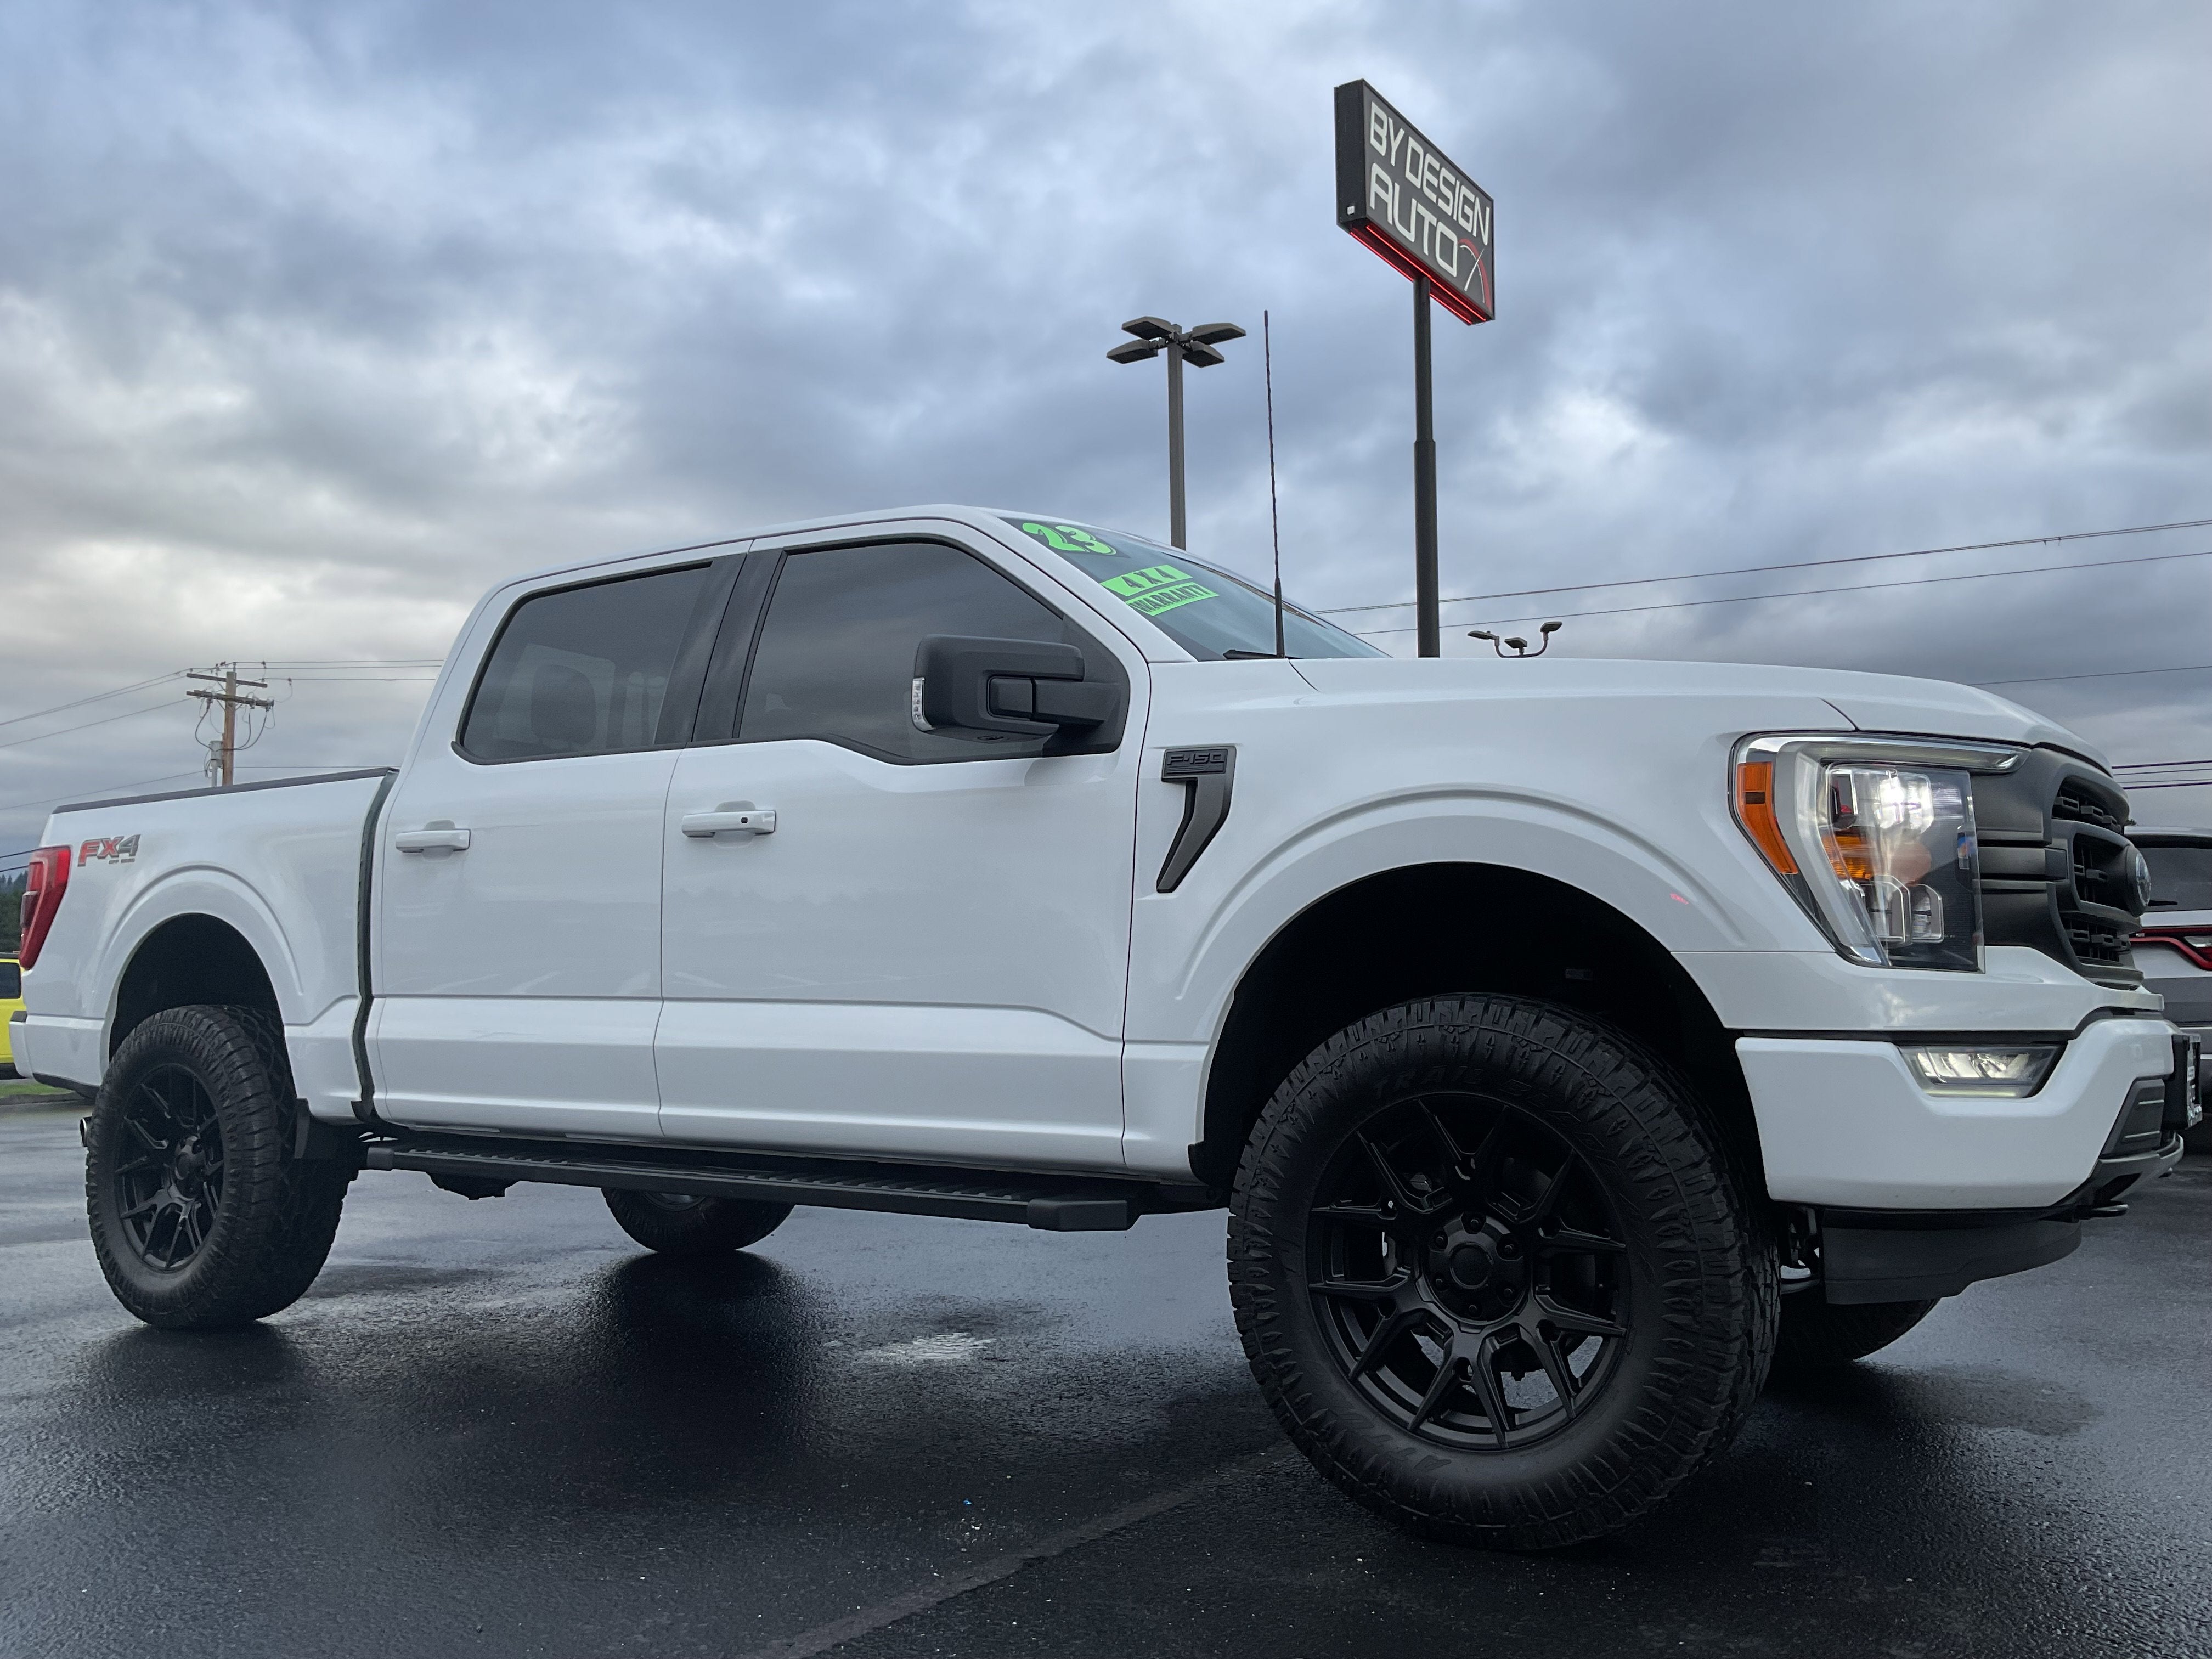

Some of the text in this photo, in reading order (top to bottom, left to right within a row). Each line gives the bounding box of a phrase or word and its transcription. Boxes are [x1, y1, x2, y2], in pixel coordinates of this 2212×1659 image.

[1370, 101, 1490, 246] BY DESIGN
[1370, 163, 1458, 277] AUTO
[1022, 522, 1116, 555] 23
[1127, 584, 1211, 613] WARRANTY
[1166, 752, 1226, 765] F-150
[77, 834, 141, 867] FX4
[1372, 1064, 1485, 1100] TRAIL
